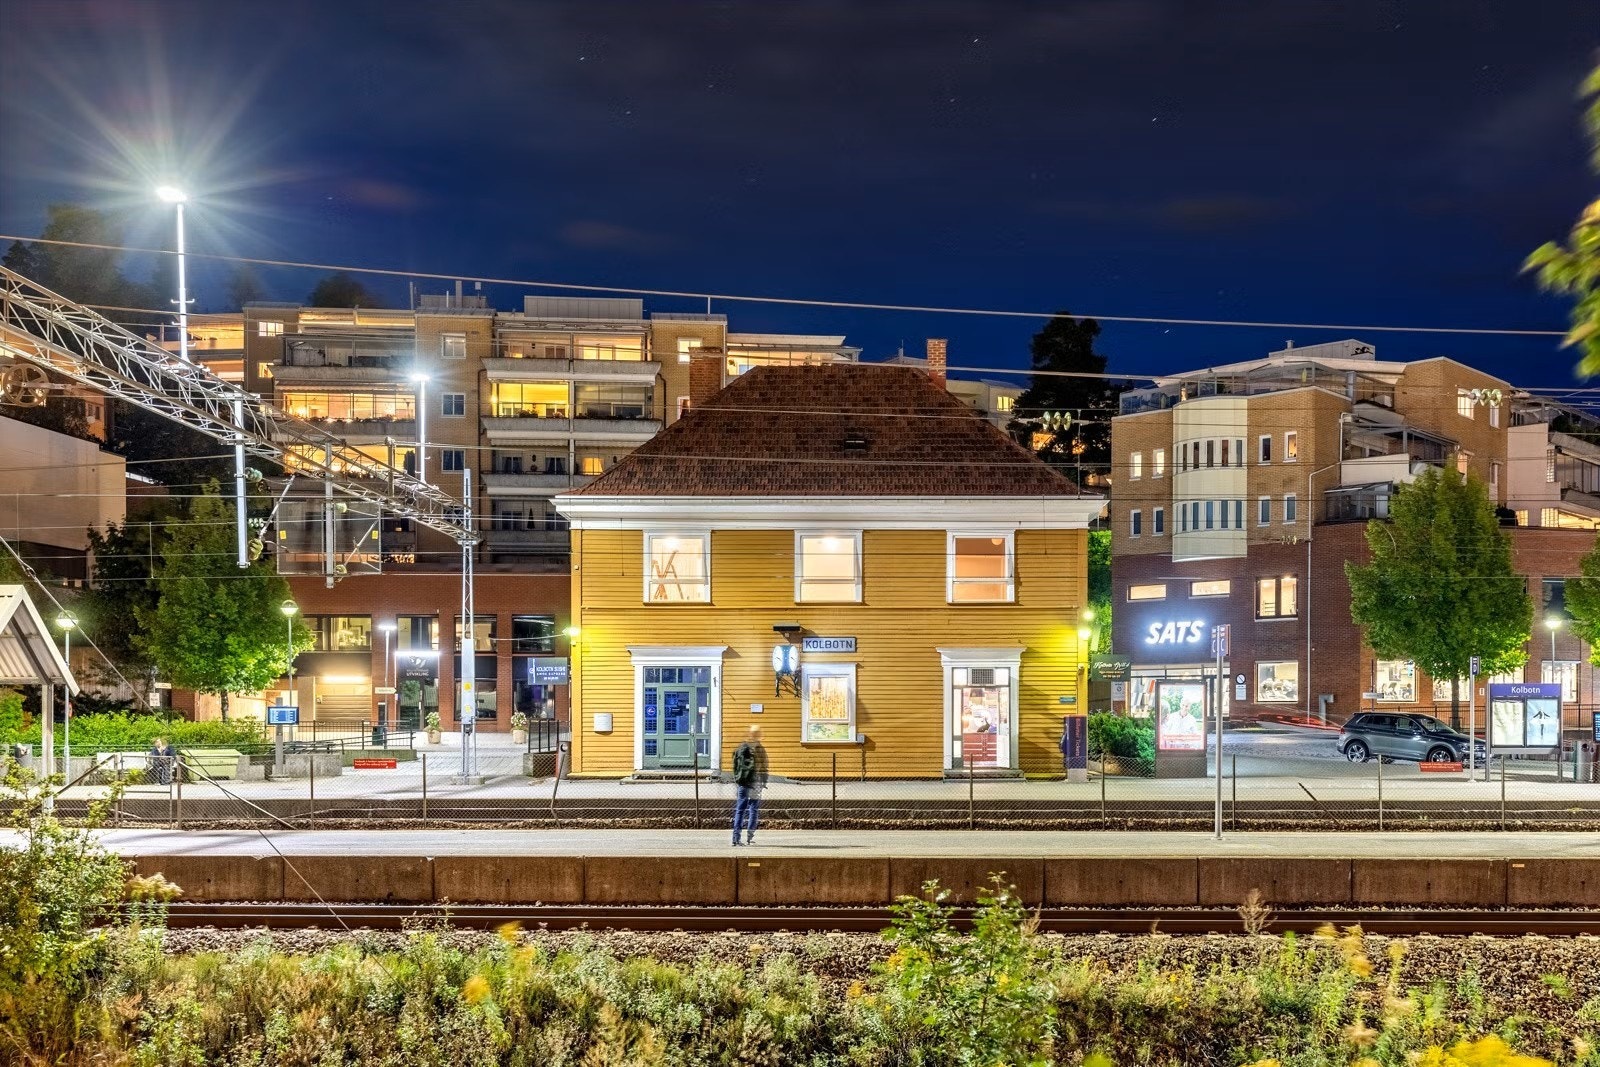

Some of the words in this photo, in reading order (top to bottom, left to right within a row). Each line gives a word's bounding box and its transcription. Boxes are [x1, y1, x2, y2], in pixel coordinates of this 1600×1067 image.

[1145, 620, 1205, 644] SATS
[805, 640, 853, 649] KOLBOTN
[1511, 686, 1541, 694] Kolbotn
